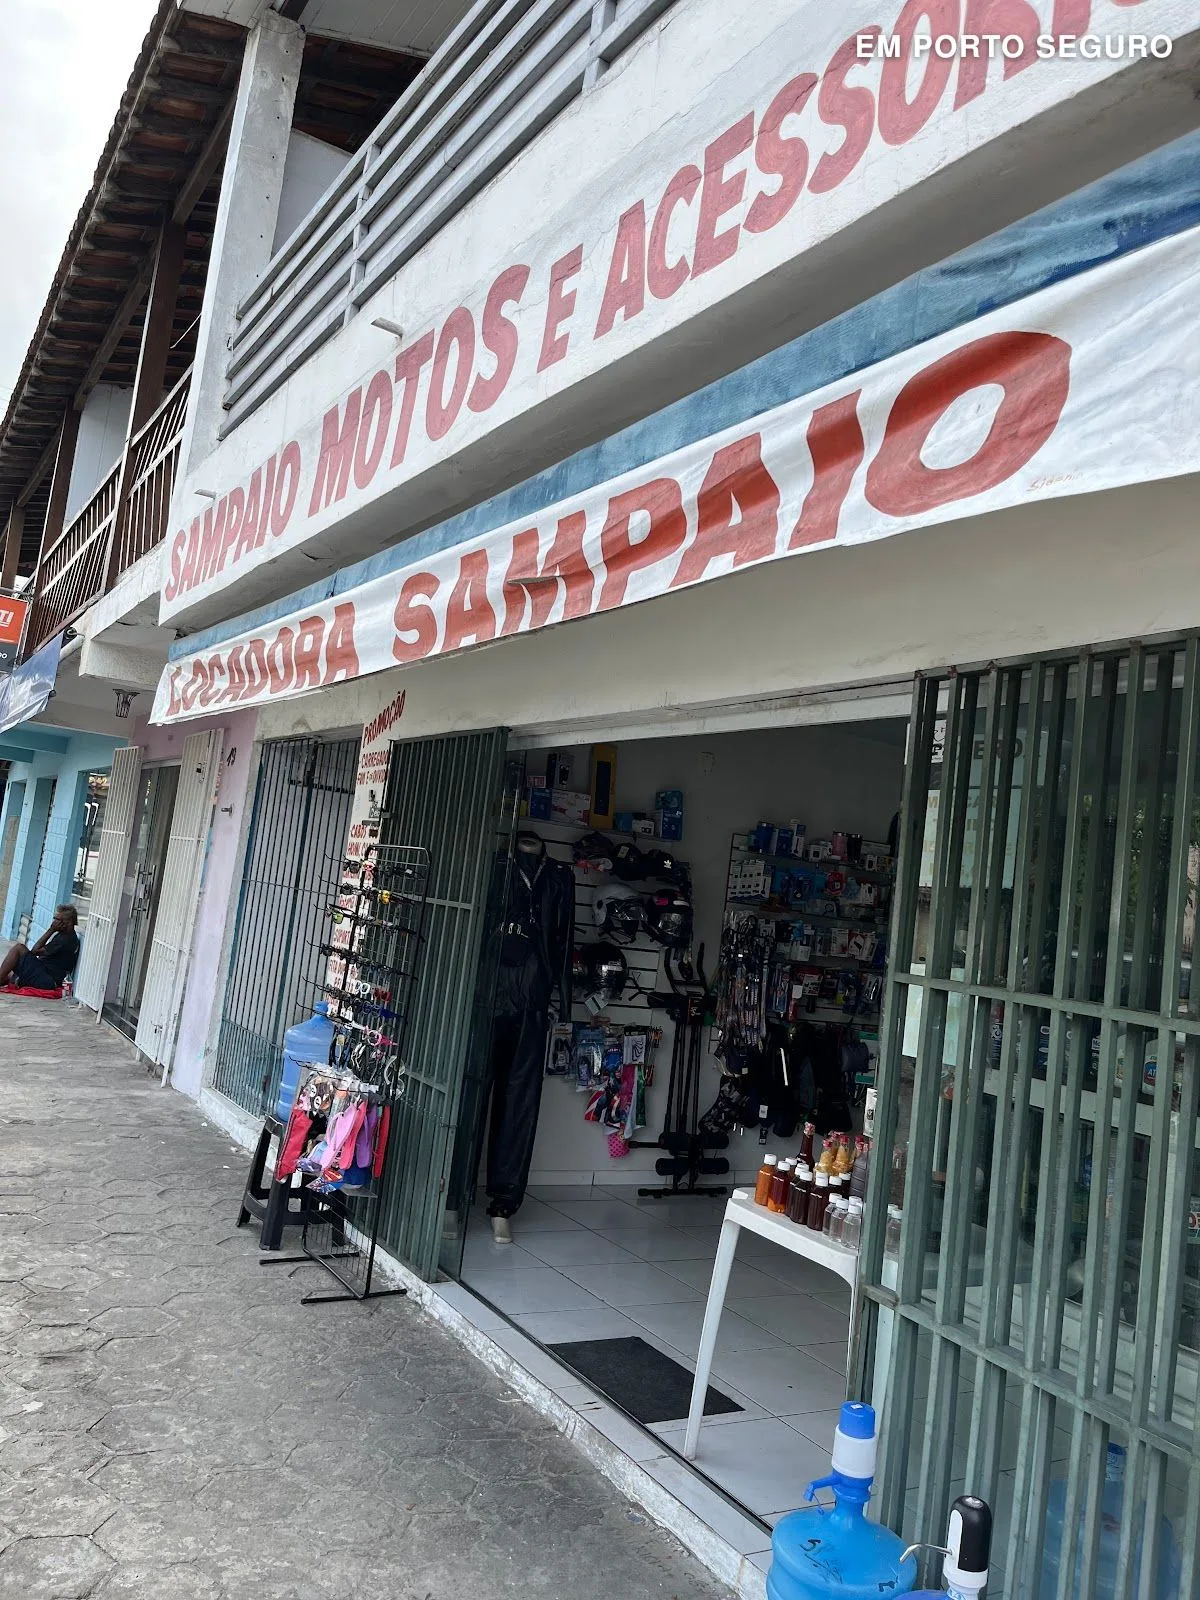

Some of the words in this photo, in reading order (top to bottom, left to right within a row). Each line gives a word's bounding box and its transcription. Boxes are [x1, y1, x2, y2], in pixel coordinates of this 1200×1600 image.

[165, 440, 301, 602] SAMPAIO
[308, 263, 531, 518] MOTOS
[536, 243, 584, 374] E
[165, 601, 360, 717] LOCADORA
[392, 330, 1073, 663] SAMPAIO
